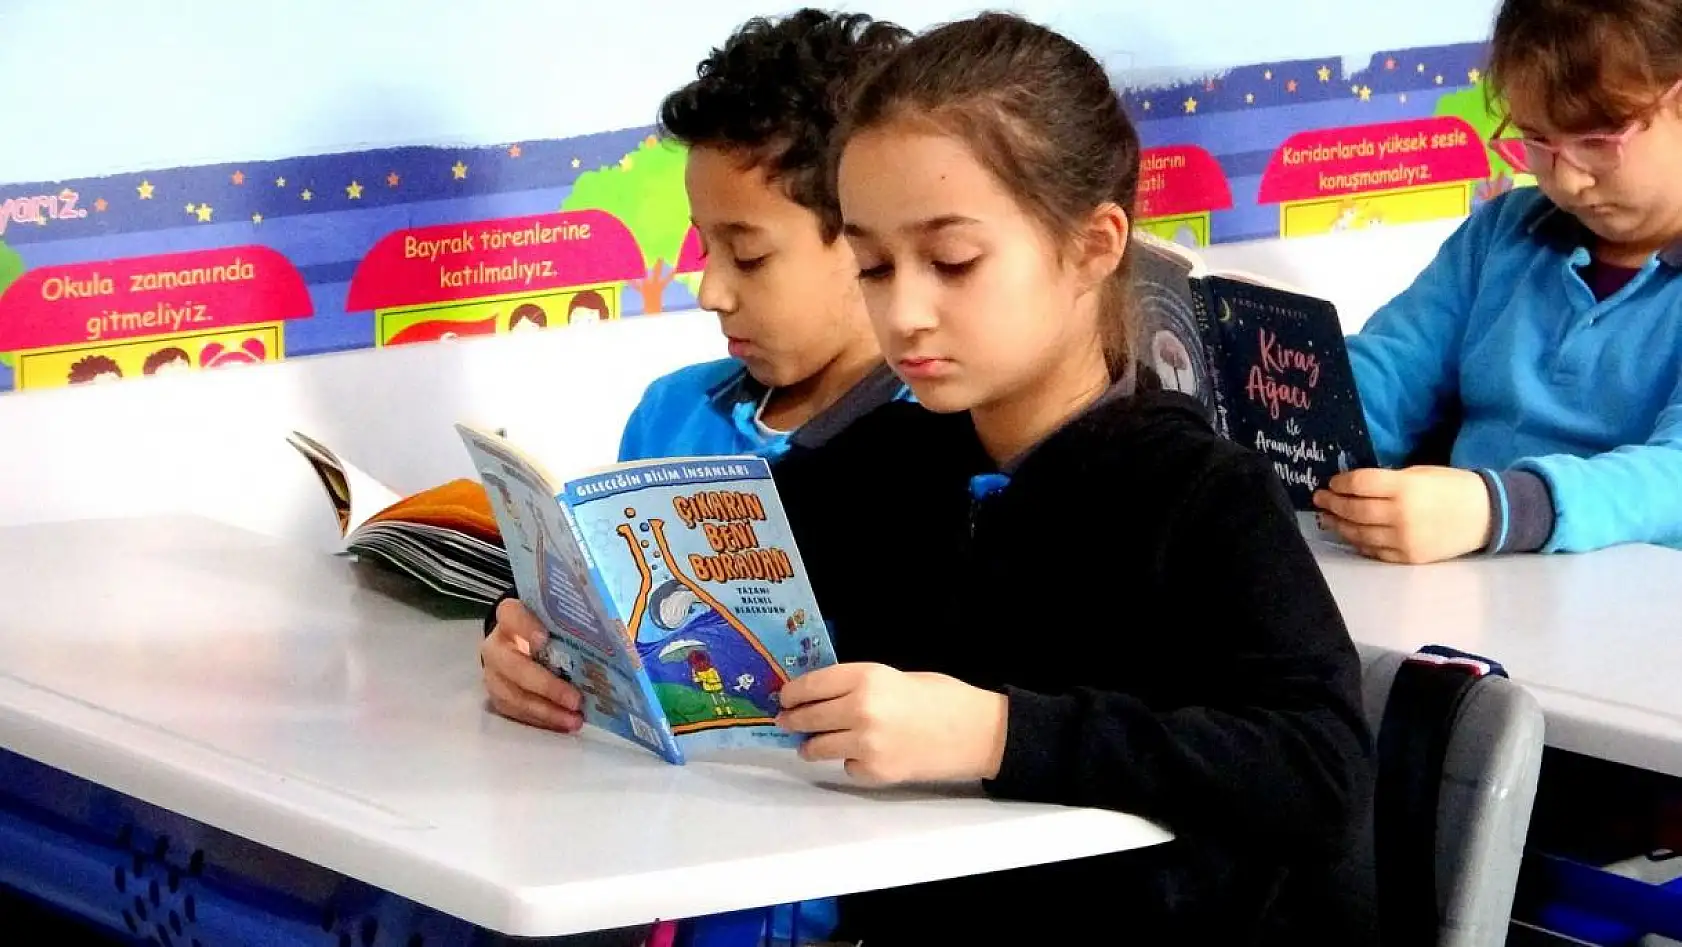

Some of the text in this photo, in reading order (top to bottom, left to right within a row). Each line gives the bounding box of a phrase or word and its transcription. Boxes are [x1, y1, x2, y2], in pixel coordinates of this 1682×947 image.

[1283, 129, 1468, 166] Koridorlarda yüksek sesle
[1319, 163, 1432, 191] konuşmamalıyız.
[404, 221, 591, 262] Bayrak törenlerine
[42, 259, 255, 301] Okula zamanında
[440, 258, 558, 289] katılmalıyız.
[86, 301, 213, 340] gitmeliyiz.
[1258, 327, 1321, 388] Kiraz
[1245, 364, 1312, 419] Ağacı
[1286, 418, 1301, 435] ile
[576, 464, 750, 497] GELECEĞİN BİLİM İNSANLARI
[673, 490, 767, 529] ÇIKARIN
[688, 548, 795, 583] BURADAN
